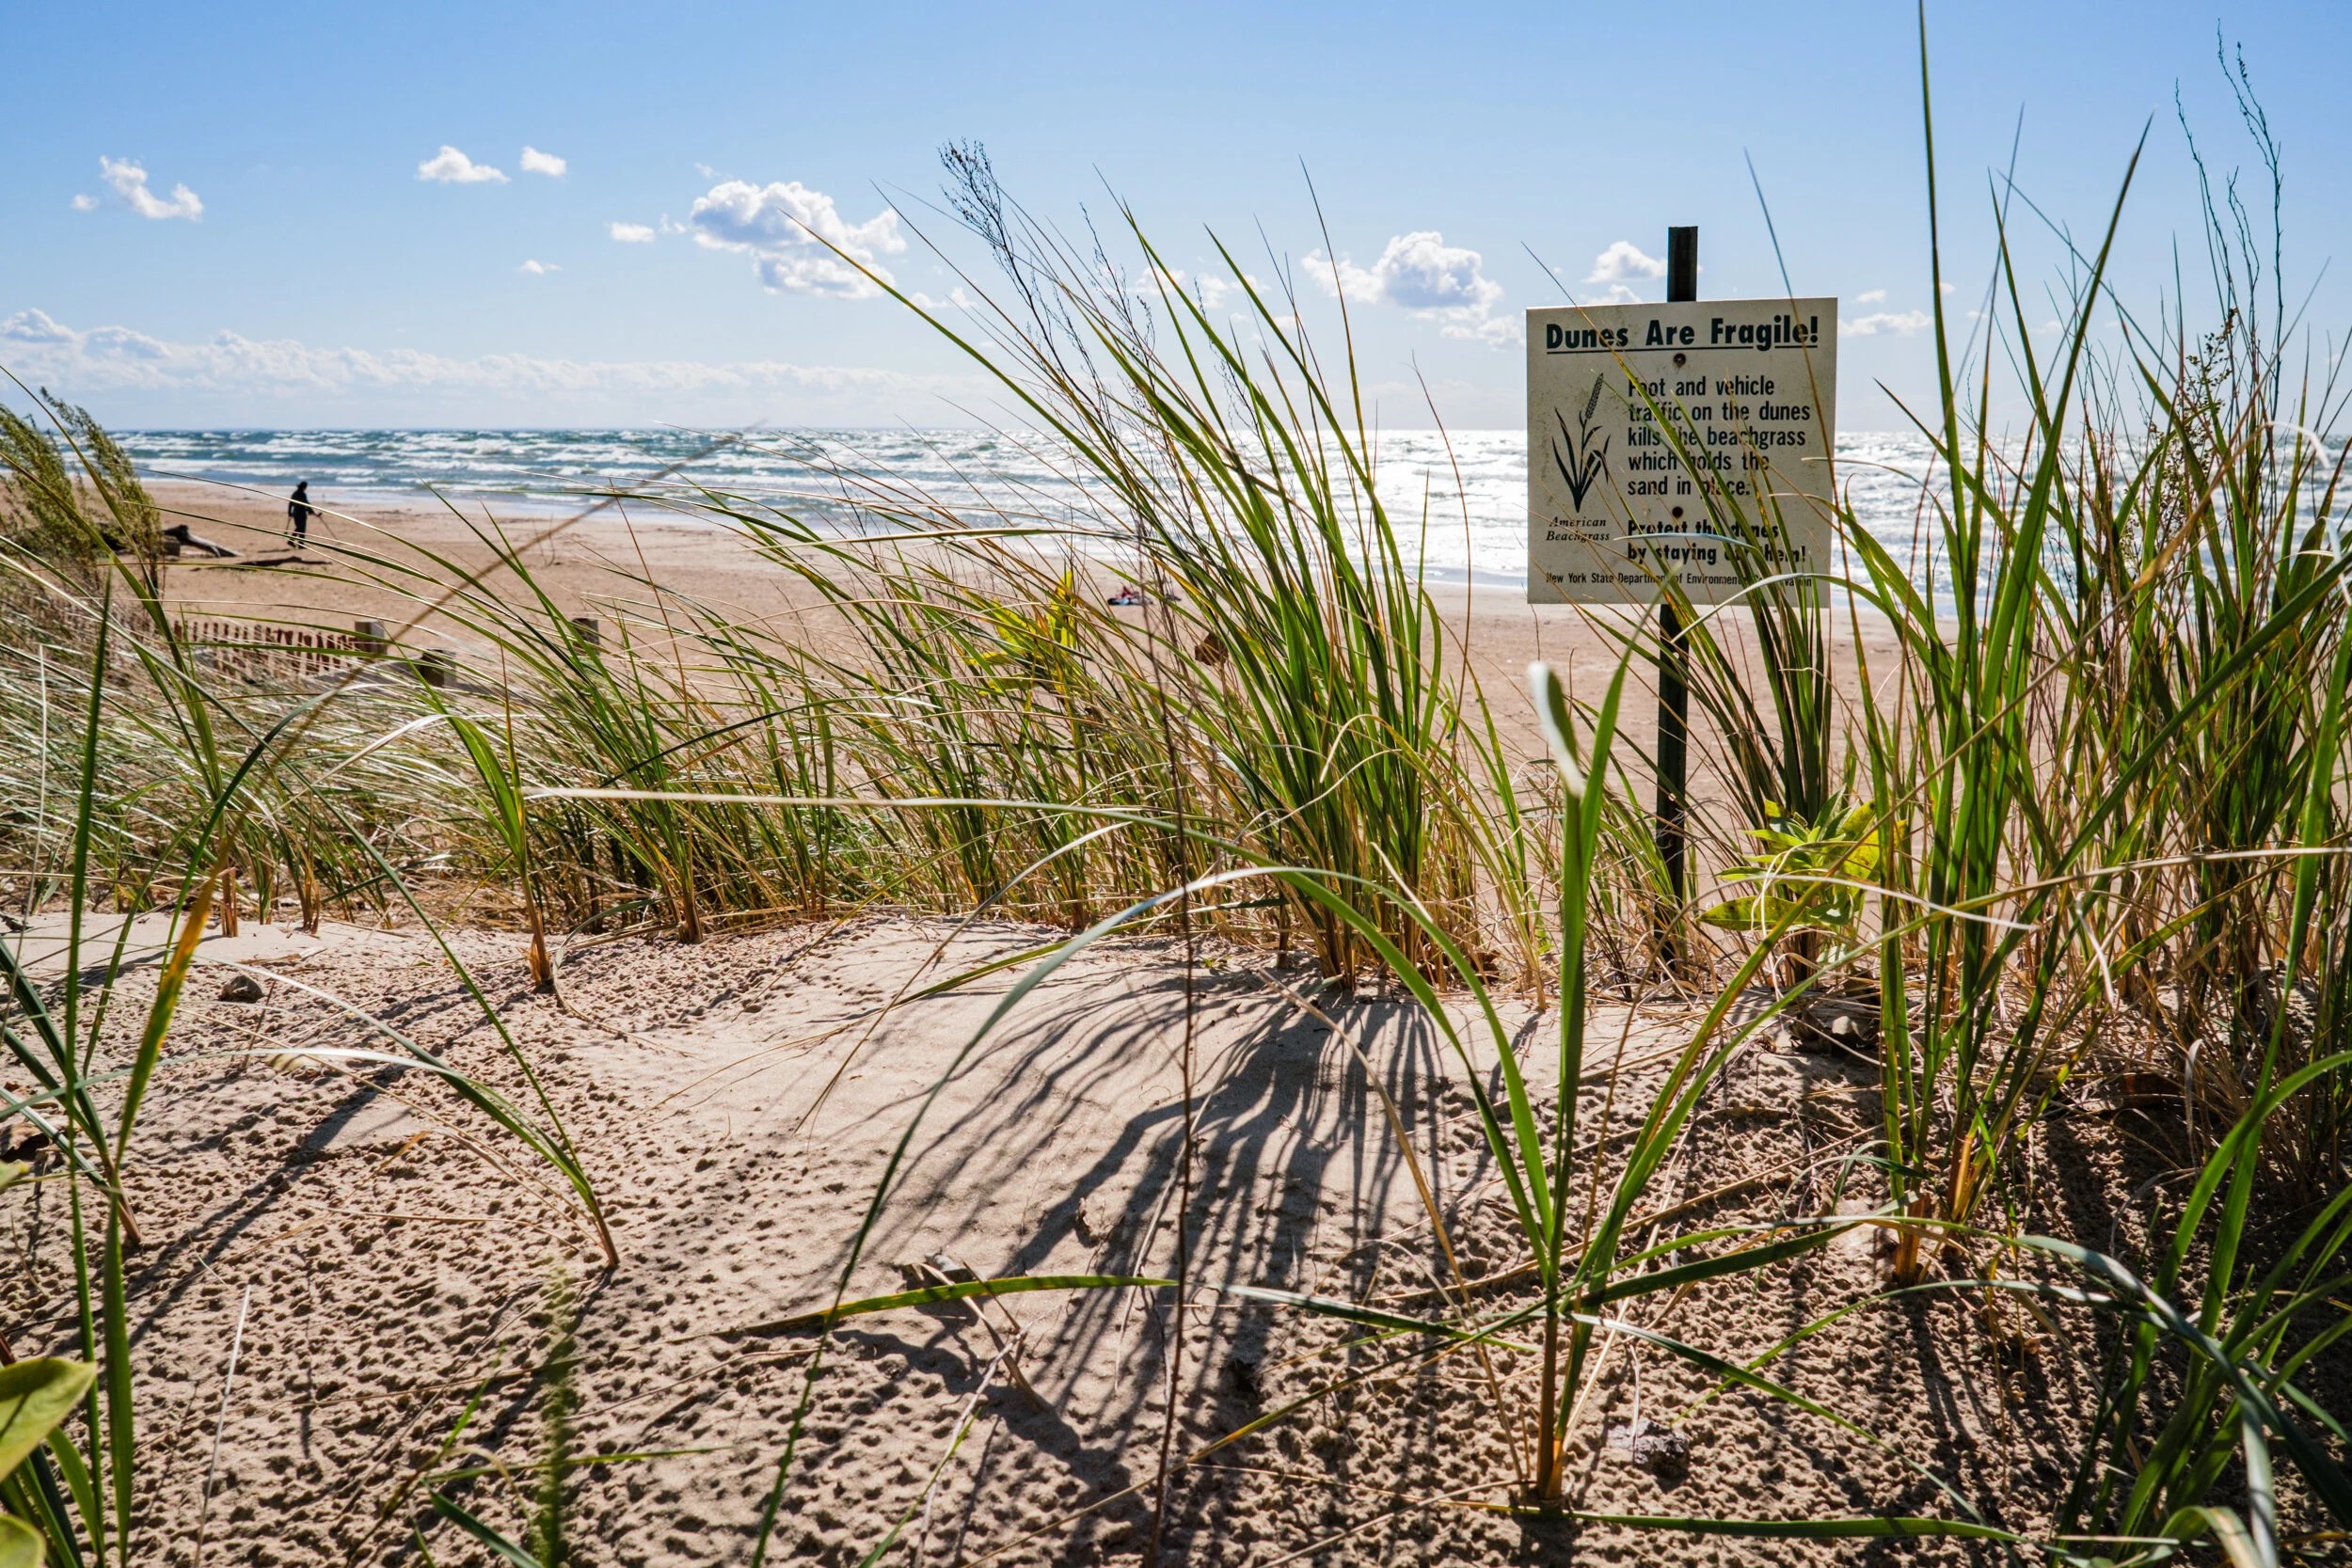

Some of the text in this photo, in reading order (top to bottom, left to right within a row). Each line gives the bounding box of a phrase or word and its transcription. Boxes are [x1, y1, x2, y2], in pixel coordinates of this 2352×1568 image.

[1547, 315, 1819, 351] Dunes Are Fragile!
[1676, 376, 1706, 396] and
[1716, 375, 1774, 395] vehicle
[1629, 401, 1810, 421] trafic on the dunes
[1629, 425, 1805, 450] kills he beachgrass
[1629, 451, 1677, 470] which
[1741, 451, 1769, 470] the
[1628, 476, 1667, 495] sand
[1677, 476, 1691, 495] in
[1549, 516, 1606, 527] American
[1628, 520, 1688, 536] Protect
[1730, 520, 1779, 538] dnes
[1546, 531, 1610, 544] Beachgrass
[1628, 543, 1646, 564] by
[1656, 543, 1716, 565] staying
[1568, 572, 1587, 583] York
[1591, 572, 1614, 583] State
